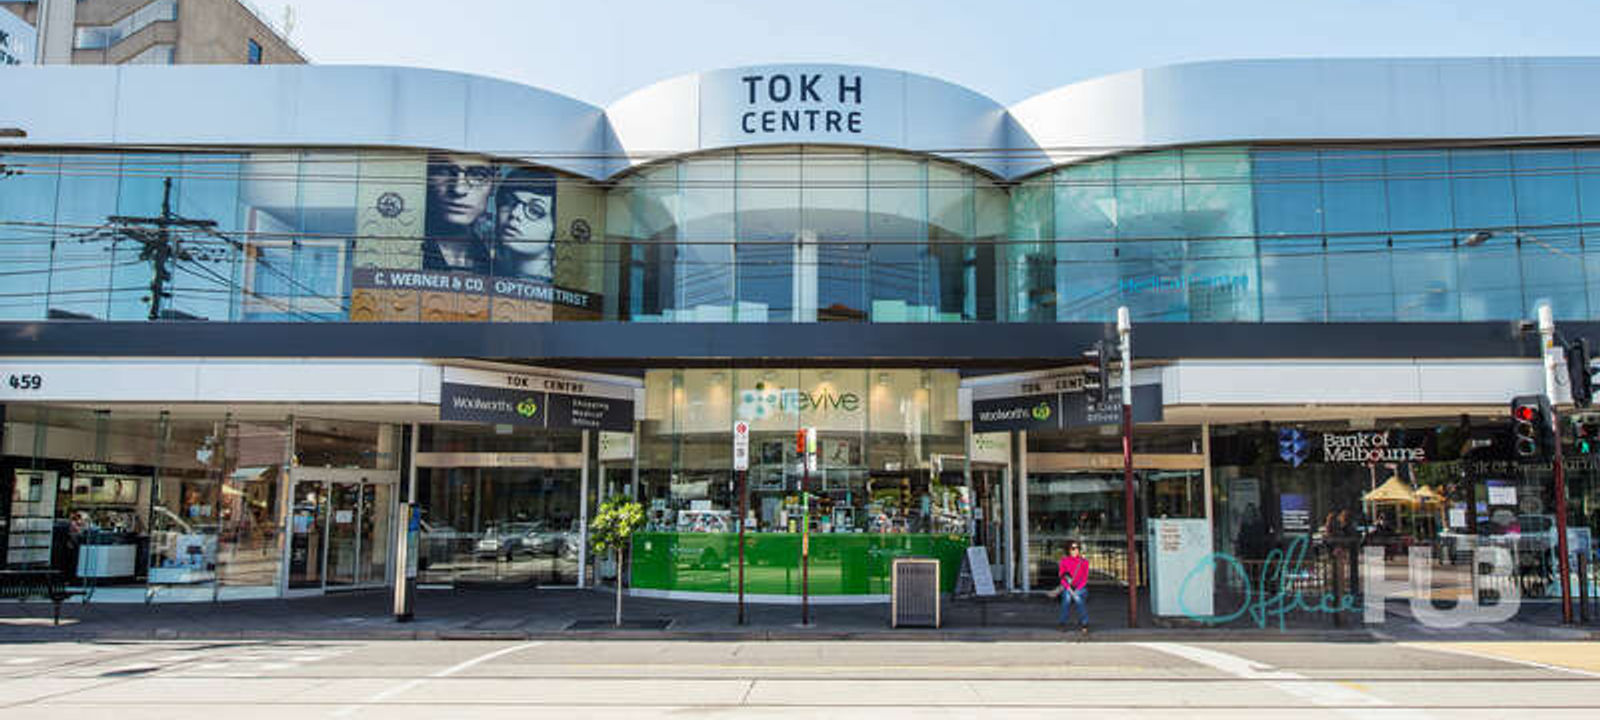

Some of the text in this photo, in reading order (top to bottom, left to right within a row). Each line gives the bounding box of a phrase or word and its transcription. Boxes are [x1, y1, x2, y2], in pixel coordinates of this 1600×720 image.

[742, 74, 861, 104] TOK H
[742, 110, 861, 133] CENTRE
[391, 273, 449, 289] WERNER
[452, 277, 462, 290] &
[495, 281, 588, 305] OPTOMETRIST
[9, 374, 42, 390] 459
[508, 375, 584, 393] TOK CENTRE
[1324, 431, 1389, 447] Bank of
[1324, 445, 1425, 463] Melbourne
